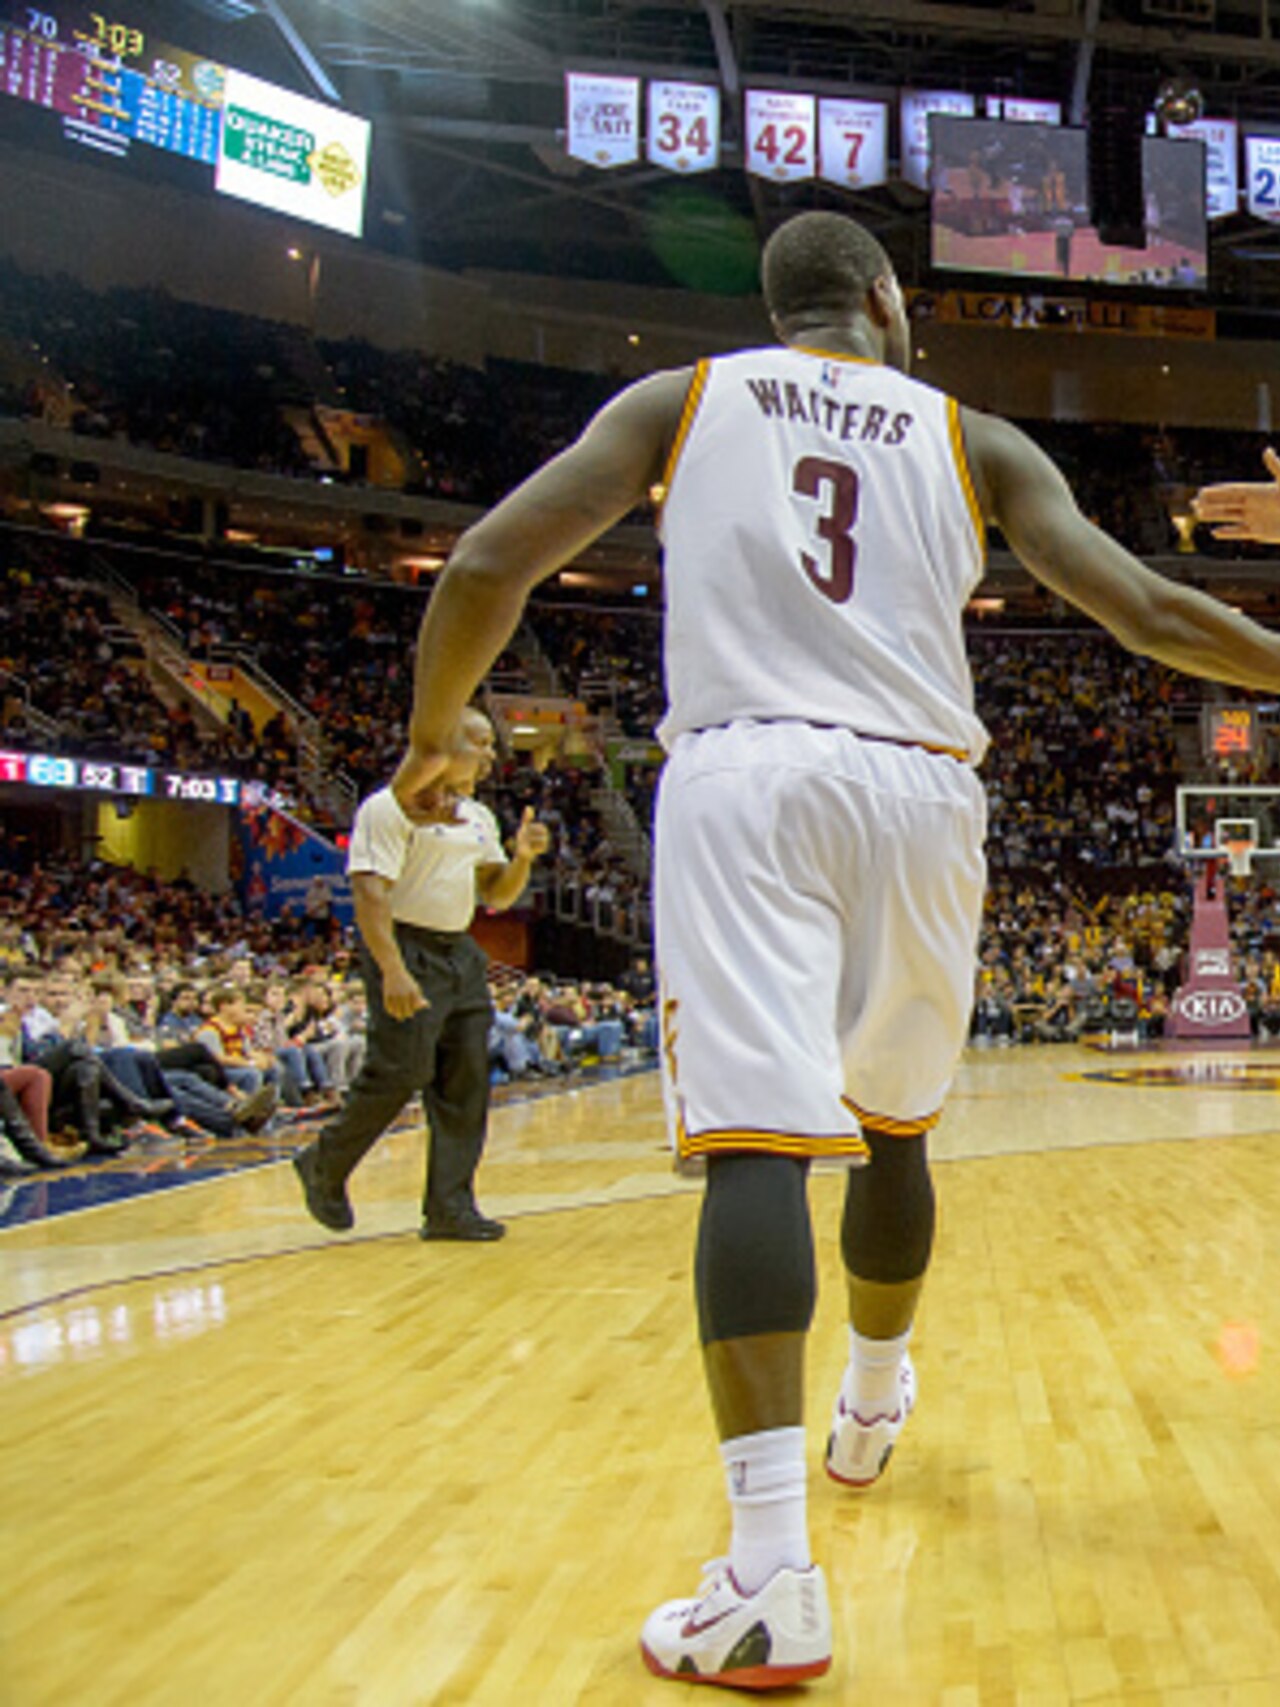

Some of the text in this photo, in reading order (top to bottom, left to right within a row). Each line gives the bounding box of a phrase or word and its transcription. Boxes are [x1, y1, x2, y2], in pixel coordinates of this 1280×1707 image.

[26, 8, 57, 38] 70
[656, 113, 711, 156] 34
[754, 123, 807, 165] 42
[843, 132, 864, 170] 7
[746, 378, 915, 446] WAITERS
[792, 455, 860, 605] 3
[165, 774, 217, 799] 7:03
[1193, 998, 1234, 1018] KIA
